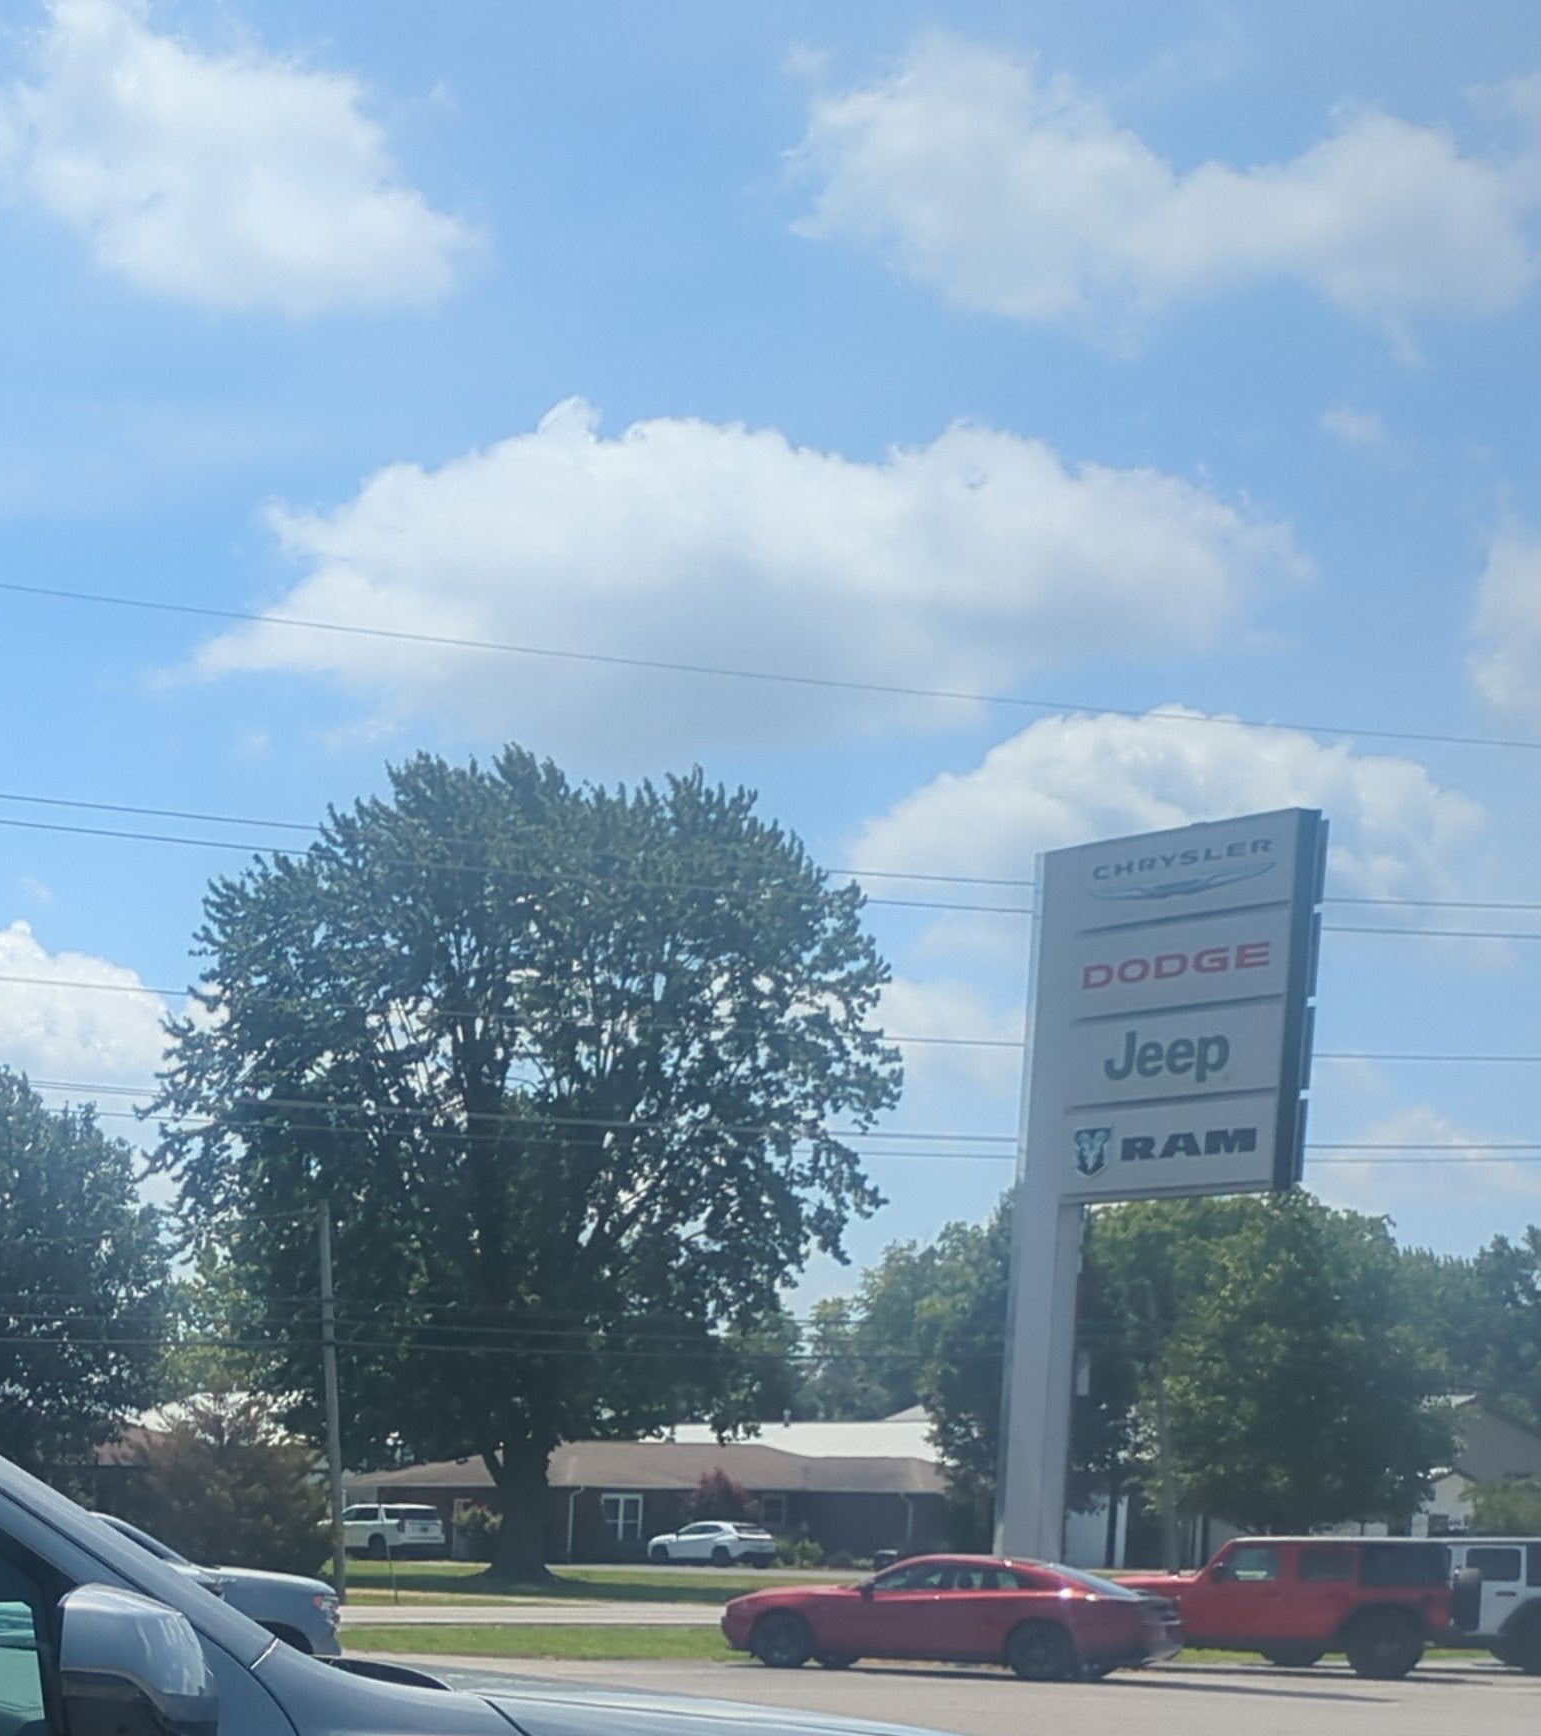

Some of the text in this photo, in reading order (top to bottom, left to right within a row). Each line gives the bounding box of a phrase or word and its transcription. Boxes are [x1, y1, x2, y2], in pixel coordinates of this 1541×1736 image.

[1092, 838, 1273, 881] CHRYSLER
[1082, 941, 1271, 989] DODGE
[1103, 1030, 1231, 1083] Jeep
[1120, 1127, 1257, 1162] RAM
